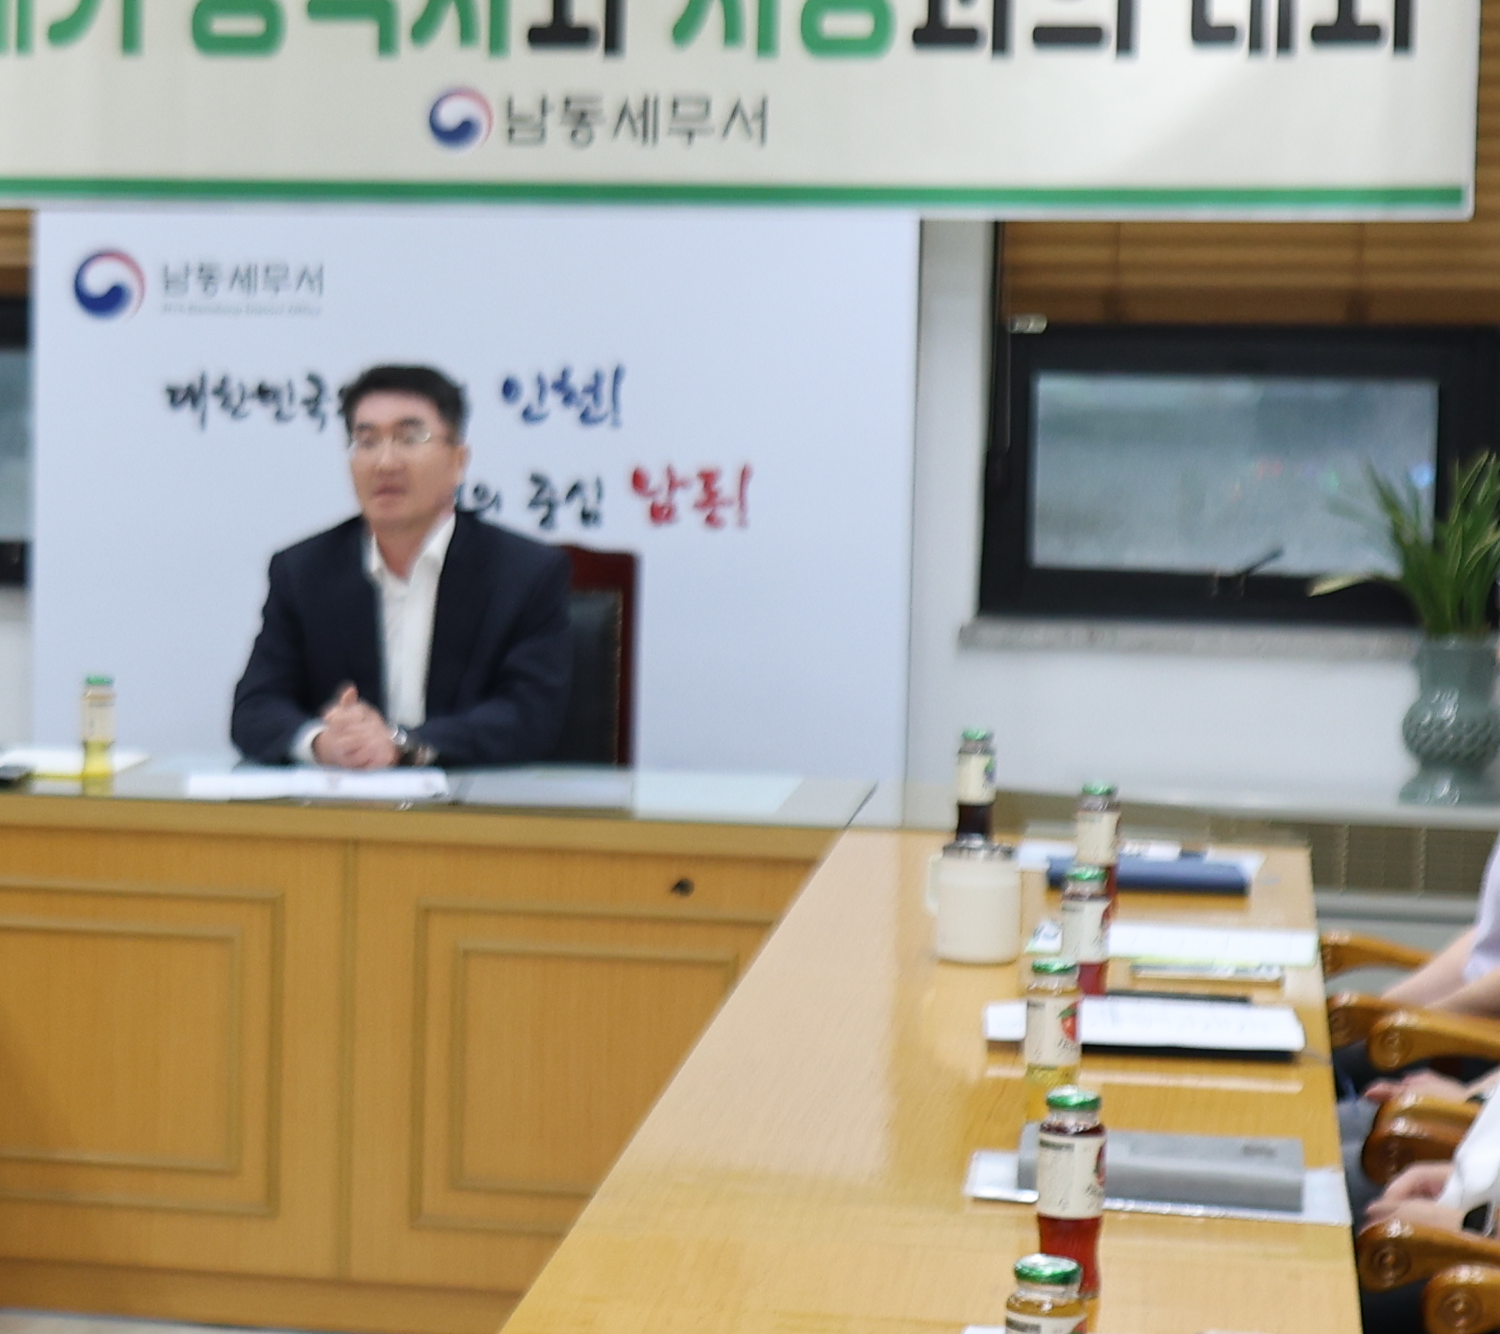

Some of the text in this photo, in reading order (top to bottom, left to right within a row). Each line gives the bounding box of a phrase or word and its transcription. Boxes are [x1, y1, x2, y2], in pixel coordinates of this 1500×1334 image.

[505, 90, 769, 150] 남동세무서
[162, 260, 324, 298] 남동세무서
[165, 371, 347, 433] 대한민국
[501, 364, 626, 430] 인천!
[528, 471, 604, 532] 중심
[631, 463, 754, 530] 남동!
